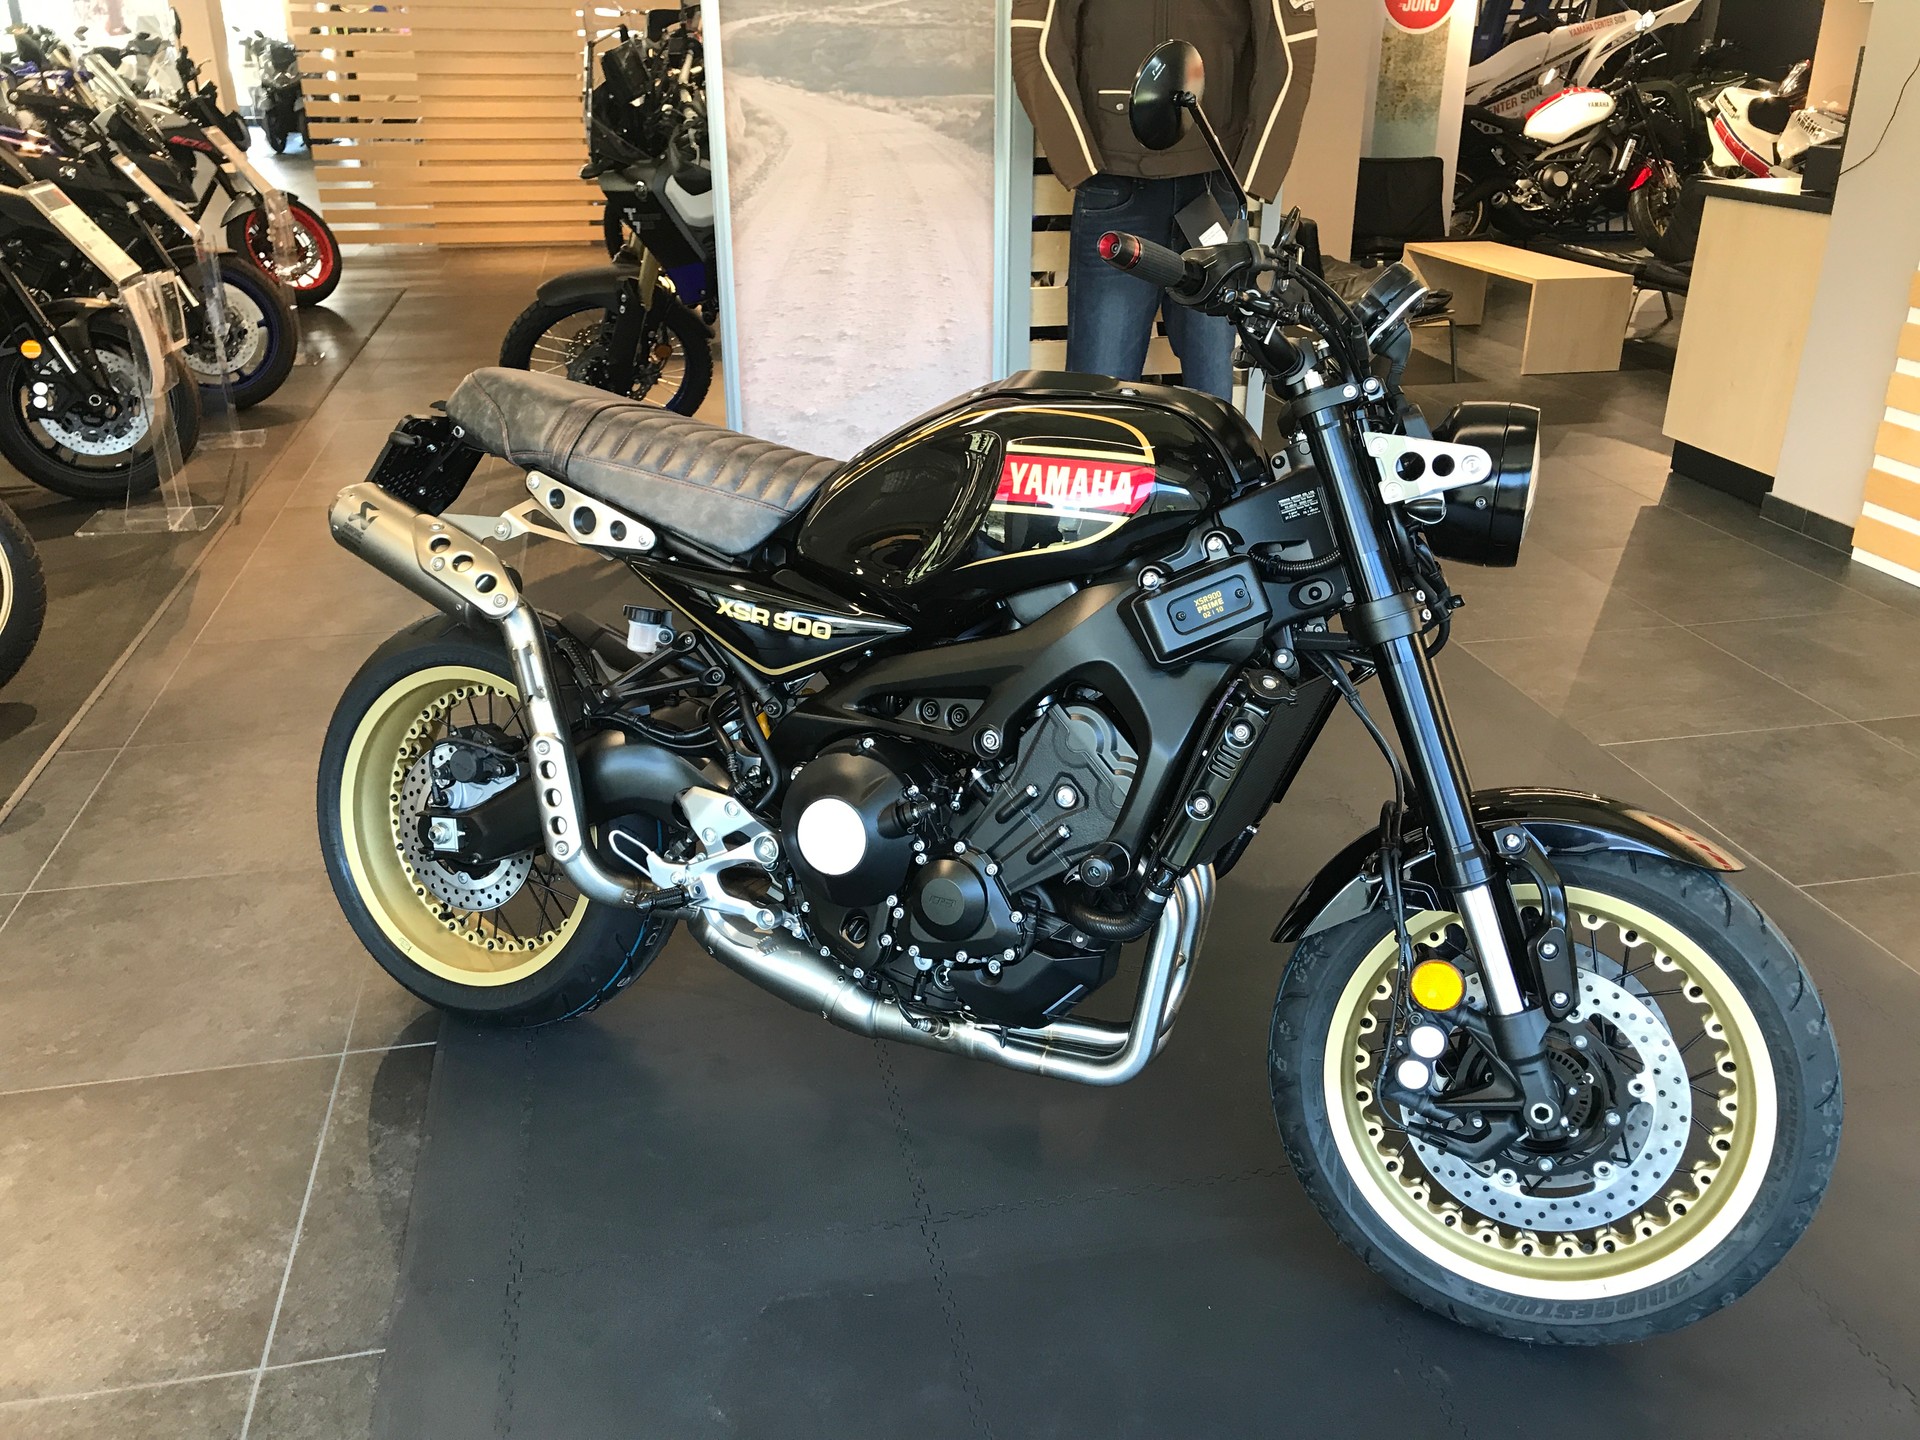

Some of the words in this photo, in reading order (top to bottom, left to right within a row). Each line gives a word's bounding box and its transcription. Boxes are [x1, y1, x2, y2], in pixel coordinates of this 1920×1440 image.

[1569, 23, 1594, 37] YAMAHA
[1594, 19, 1613, 31] CENTER
[1487, 96, 1517, 114] ENTER
[1010, 461, 1132, 505] YAMAHA
[1194, 591, 1222, 606] XSR900
[1197, 598, 1224, 613] PRIME
[716, 597, 770, 627] XSR
[773, 612, 832, 640] 900
